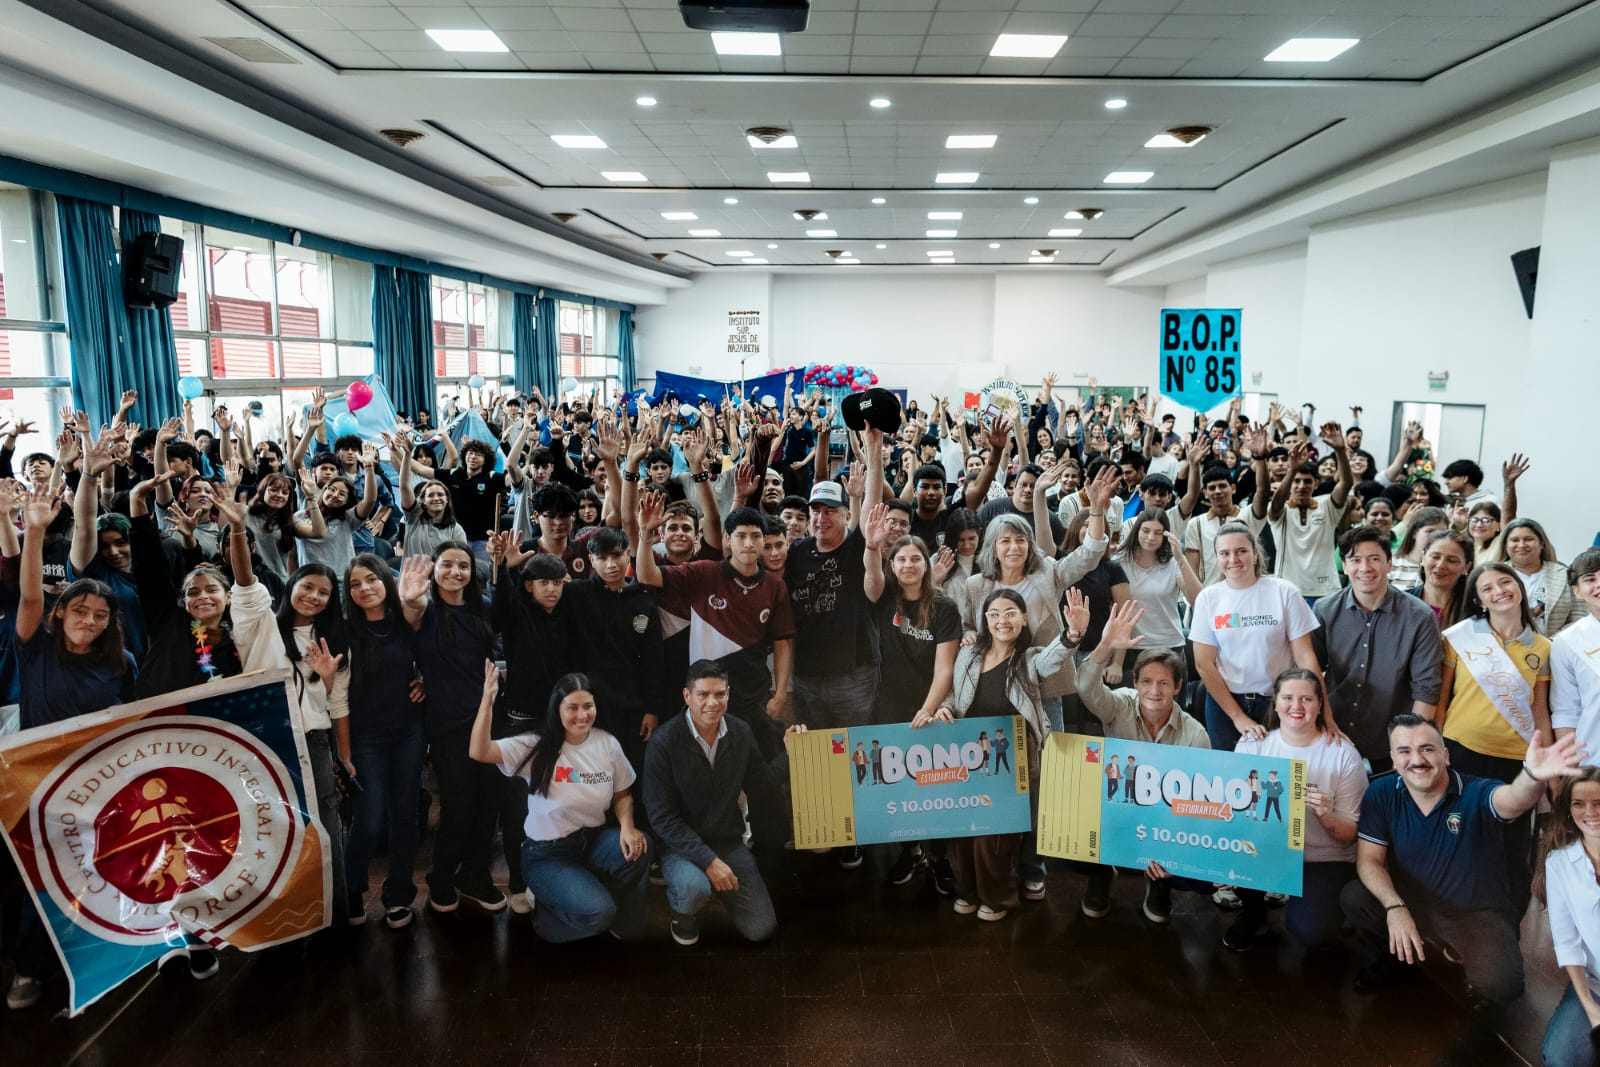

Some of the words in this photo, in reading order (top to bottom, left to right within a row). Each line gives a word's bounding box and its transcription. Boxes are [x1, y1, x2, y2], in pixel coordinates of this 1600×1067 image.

[728, 317, 760, 326] INSTITUTO
[736, 327, 750, 335] SUP.
[1164, 313, 1238, 352] B.O.P.
[728, 335, 747, 344] JESUS
[749, 335, 758, 344] DE
[728, 344, 760, 353] NAZARETH
[1205, 355, 1235, 394] 85
[1241, 614, 1273, 622] MISIONES
[1242, 619, 1278, 627] JUVENTUD
[880, 741, 984, 785] BONO
[66, 741, 208, 807] EDUCATIVO
[213, 748, 273, 841] INTEGRAL
[1134, 764, 1253, 812] BONO
[886, 799, 897, 815] $
[1176, 803, 1218, 816] ESTUDIANTIL
[1136, 823, 1147, 840] $
[170, 868, 258, 923] ORGE
